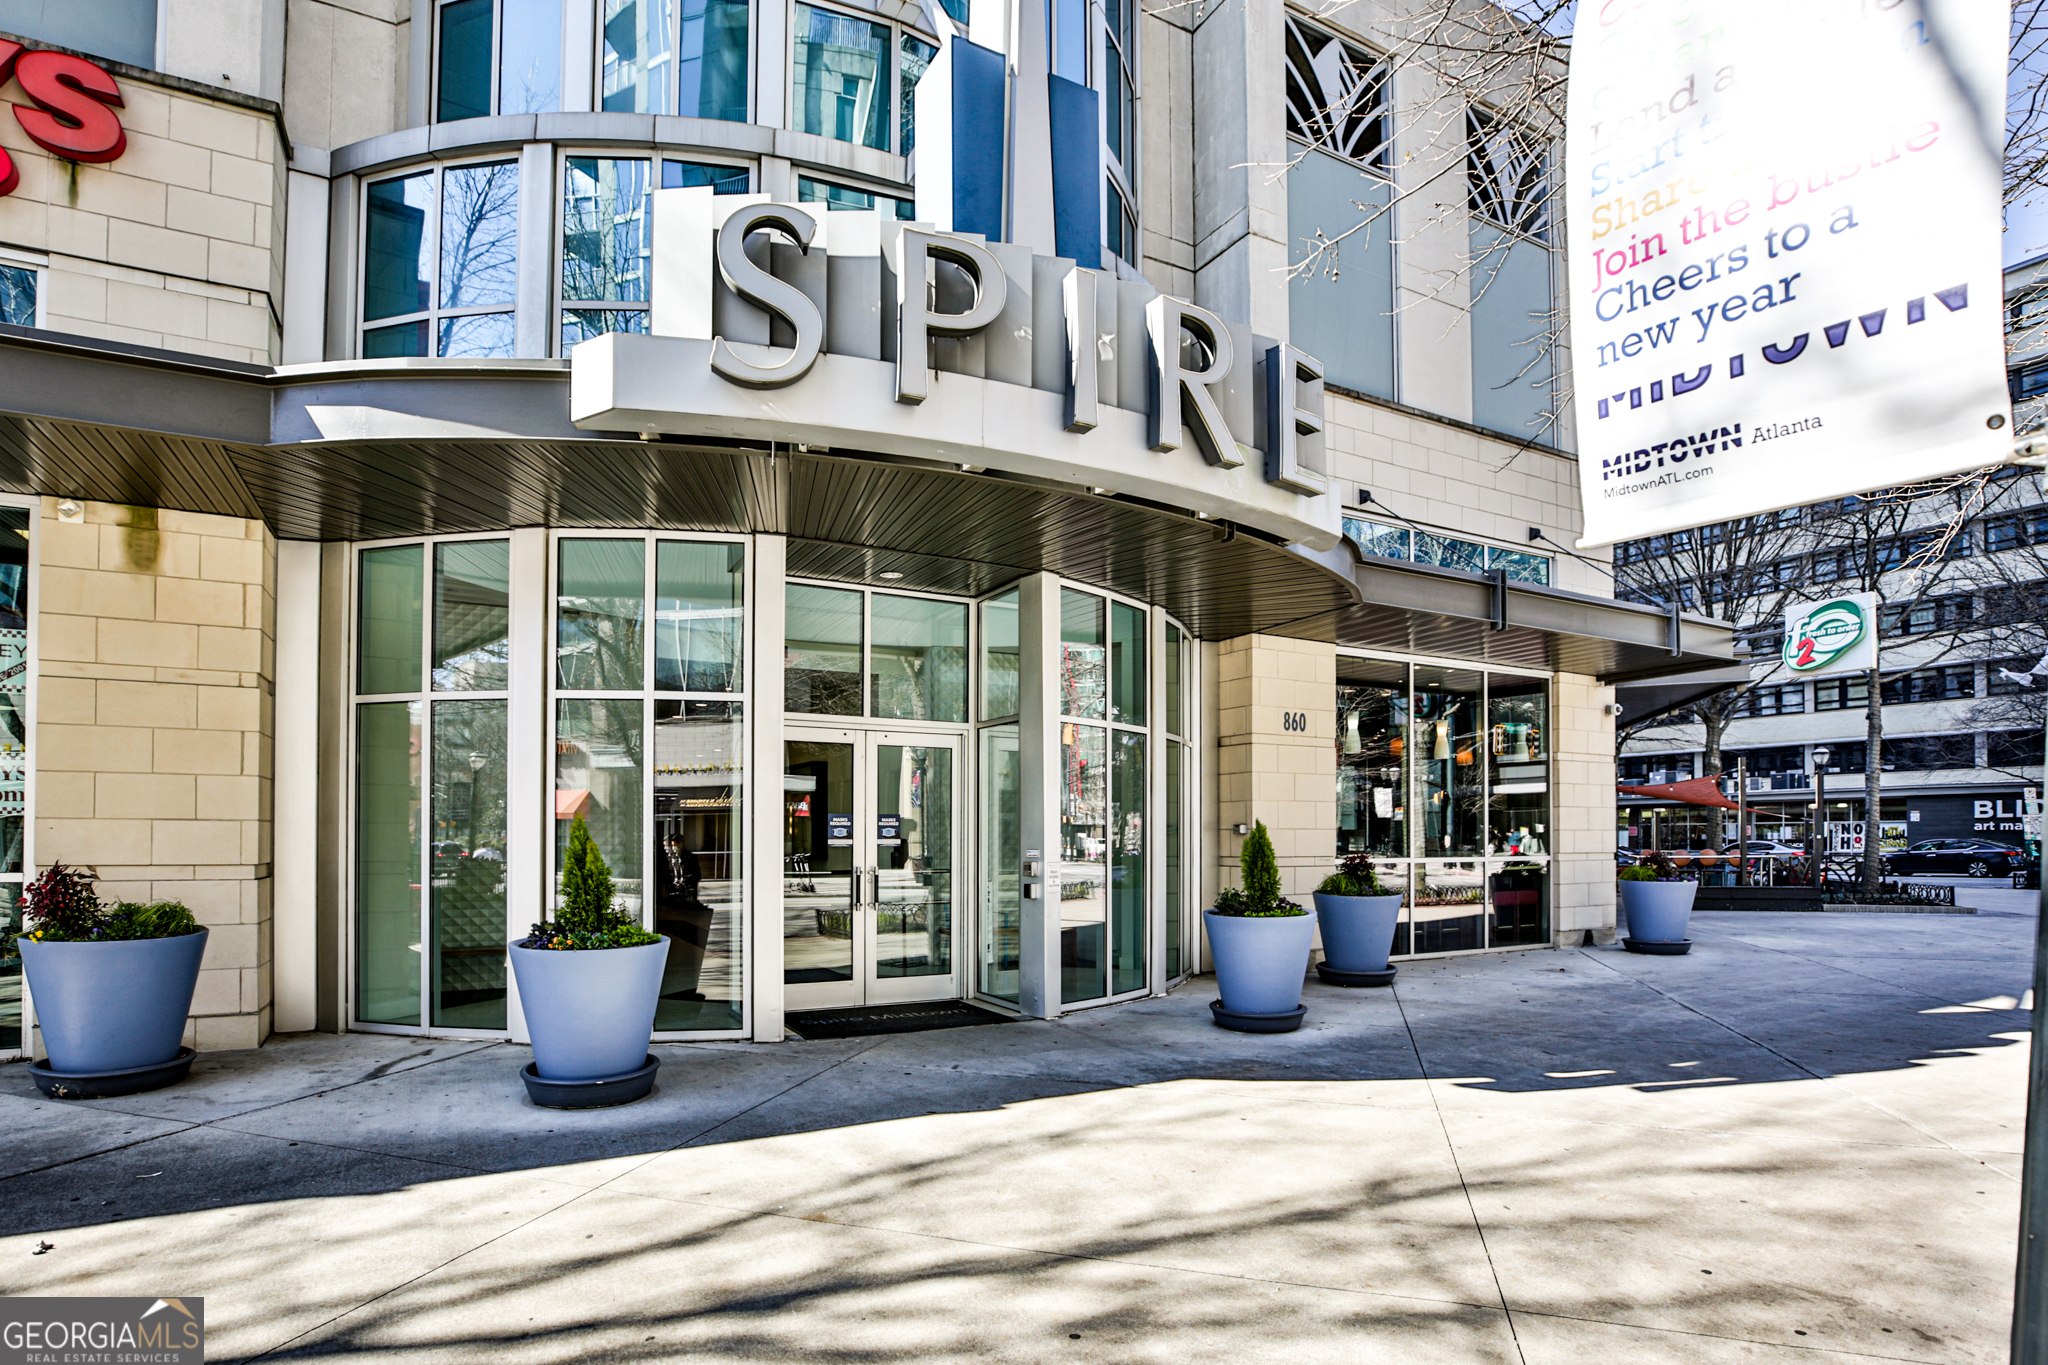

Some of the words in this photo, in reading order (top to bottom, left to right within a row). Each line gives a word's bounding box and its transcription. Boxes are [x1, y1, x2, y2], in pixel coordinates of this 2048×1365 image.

[1591, 73, 1698, 156] Lend
[1591, 126, 1685, 198] Start
[1592, 168, 1712, 240] Share
[1591, 233, 1668, 293] Join
[1680, 198, 1750, 246] the
[1595, 243, 1749, 322] Cheers
[1764, 220, 1811, 259] to
[1828, 204, 1859, 235] a
[709, 203, 1328, 498] SPIRE
[1597, 315, 1681, 367] new
[1691, 271, 1802, 343] year
[1602, 422, 1743, 481] MIDTOWN
[1751, 413, 1823, 445] Atlanta
[1603, 463, 1714, 499] MidtownATL.com
[1805, 628, 1827, 639] fresh
[1827, 626, 1836, 635] to
[1836, 623, 1860, 633] order
[1283, 711, 1306, 732] 860
[1974, 822, 1995, 831] art
[2000, 823, 2024, 831] ma
